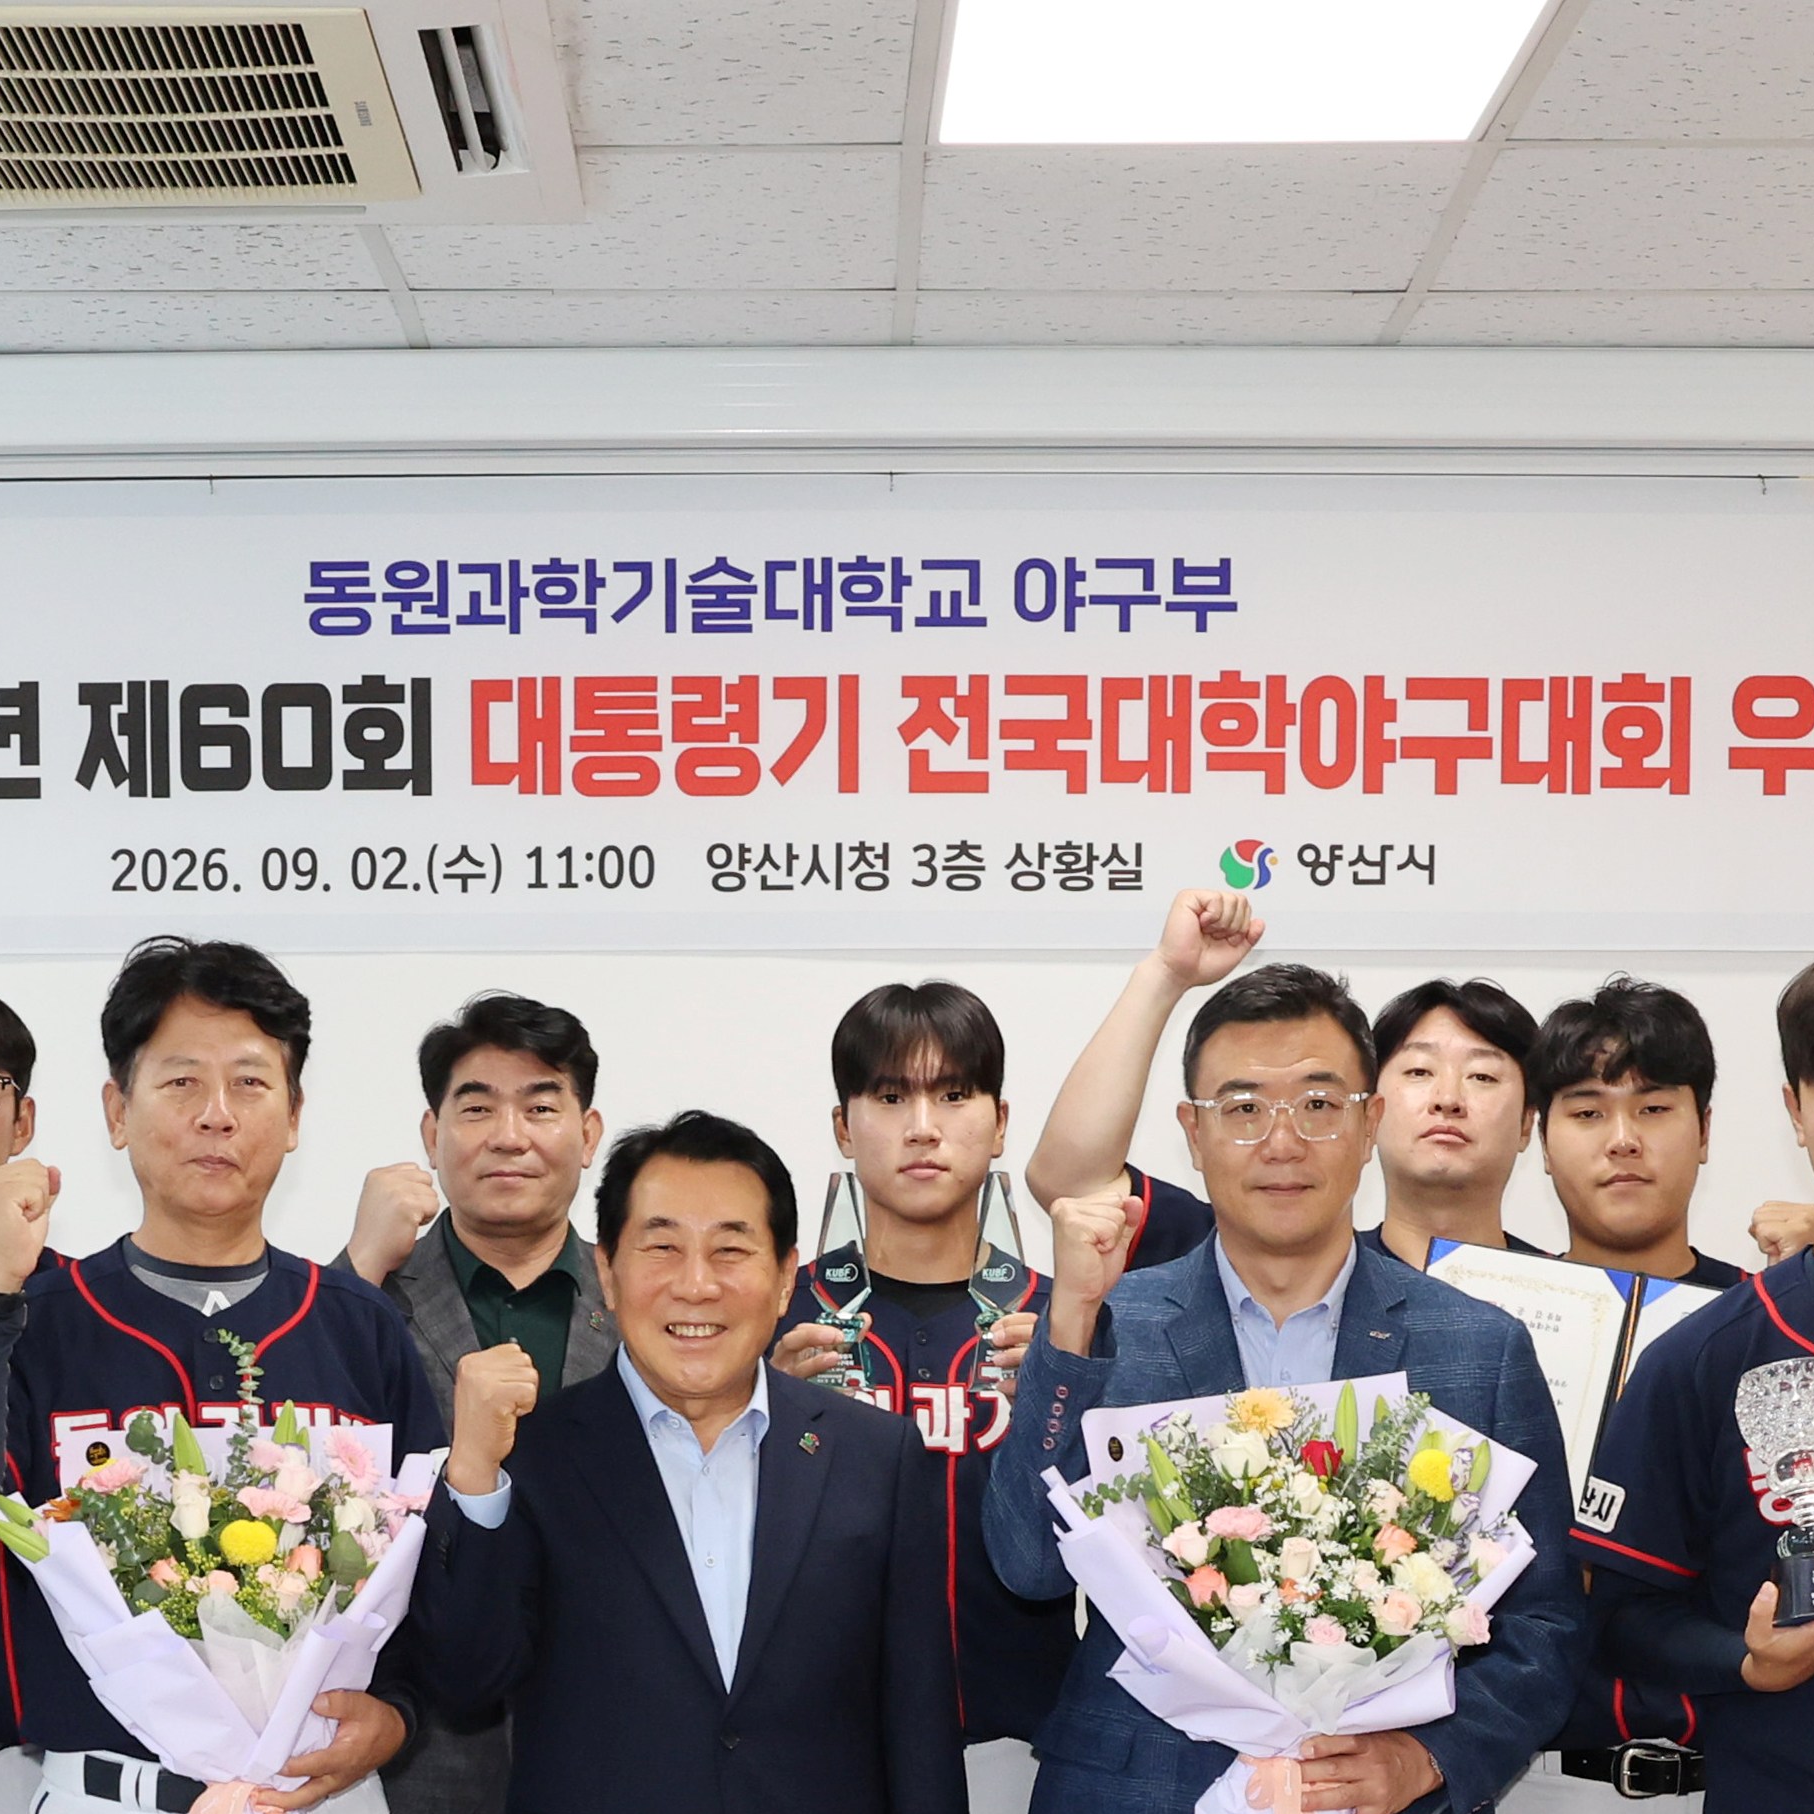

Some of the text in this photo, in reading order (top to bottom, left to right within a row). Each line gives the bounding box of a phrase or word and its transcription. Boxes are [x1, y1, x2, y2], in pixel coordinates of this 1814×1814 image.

[304, 555, 1237, 636] 동원과학기술대학교 야구부
[75, 675, 432, 798] 제60회
[471, 675, 859, 797] 대통령기
[897, 671, 1691, 797] 전국대학야구대회
[111, 840, 1435, 894] 2026. 09. 02.(수) 11:00 양산시청 3층 상황실 양산시
